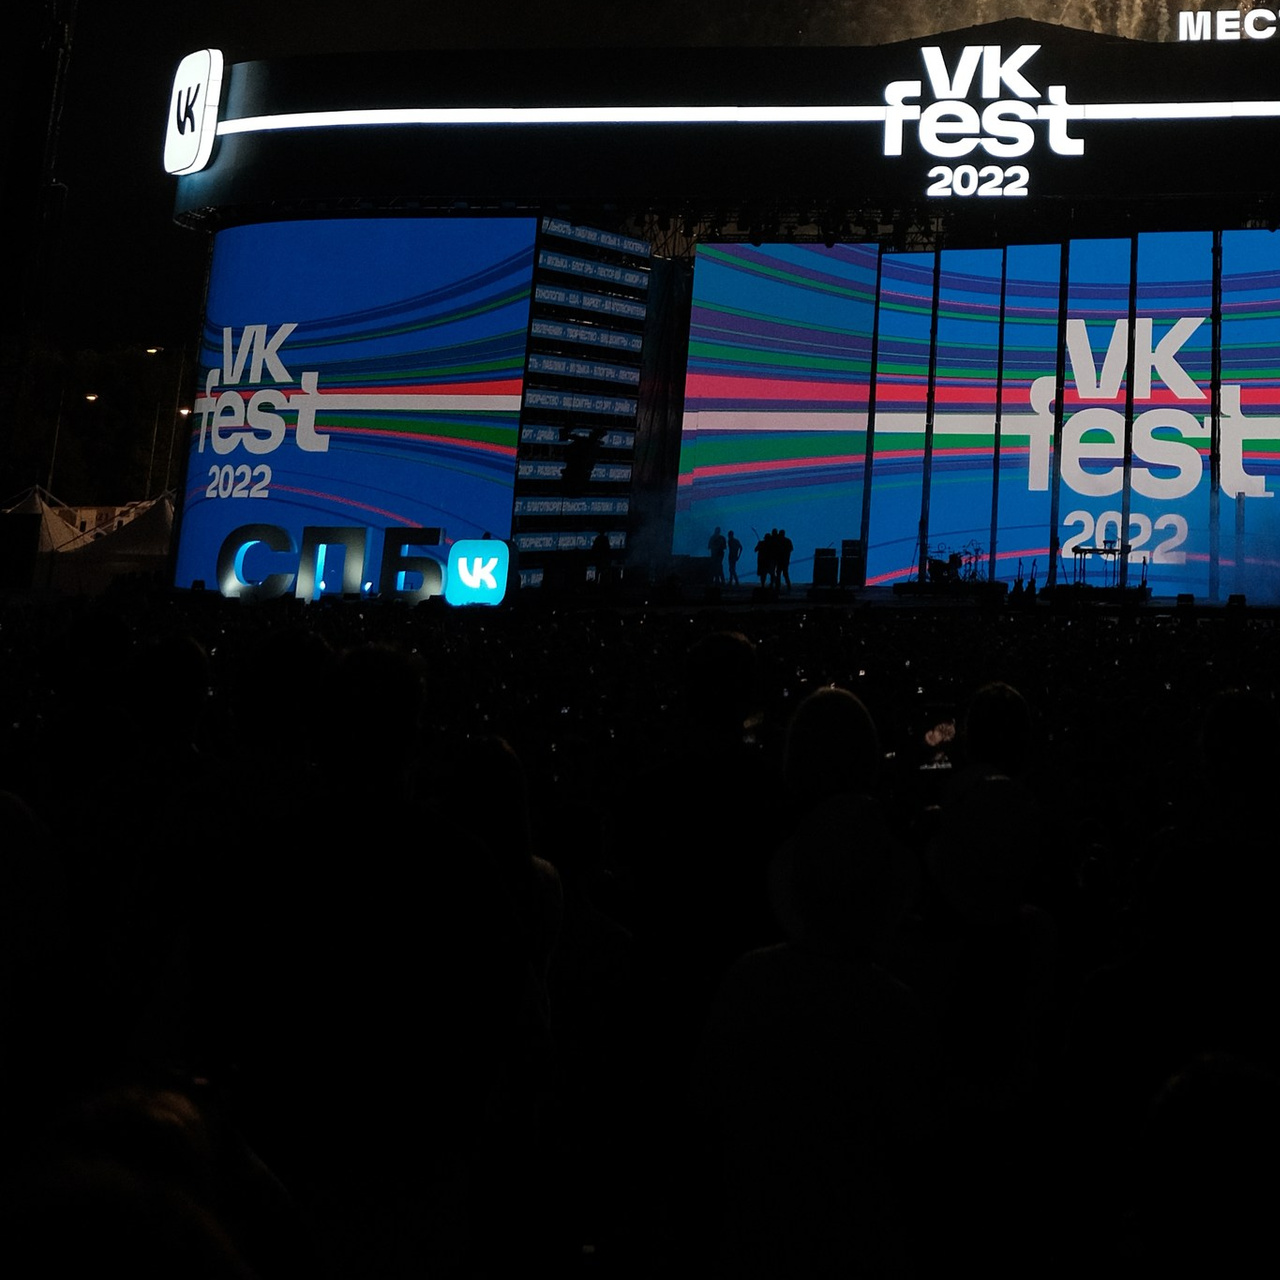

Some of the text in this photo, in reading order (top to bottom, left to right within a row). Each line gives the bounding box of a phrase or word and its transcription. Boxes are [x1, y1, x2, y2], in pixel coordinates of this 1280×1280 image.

[921, 44, 1042, 100] VK
[176, 83, 201, 135] VK
[883, 80, 1085, 158] fest
[926, 164, 1030, 197] 2022
[222, 323, 299, 385] VK
[1065, 317, 1208, 399] VK
[195, 369, 330, 455] fest
[1028, 376, 1270, 500] fest
[206, 464, 272, 509] 2022
[216, 523, 447, 603] СПБ
[1061, 510, 1189, 564] 2022
[457, 556, 499, 589] VK
